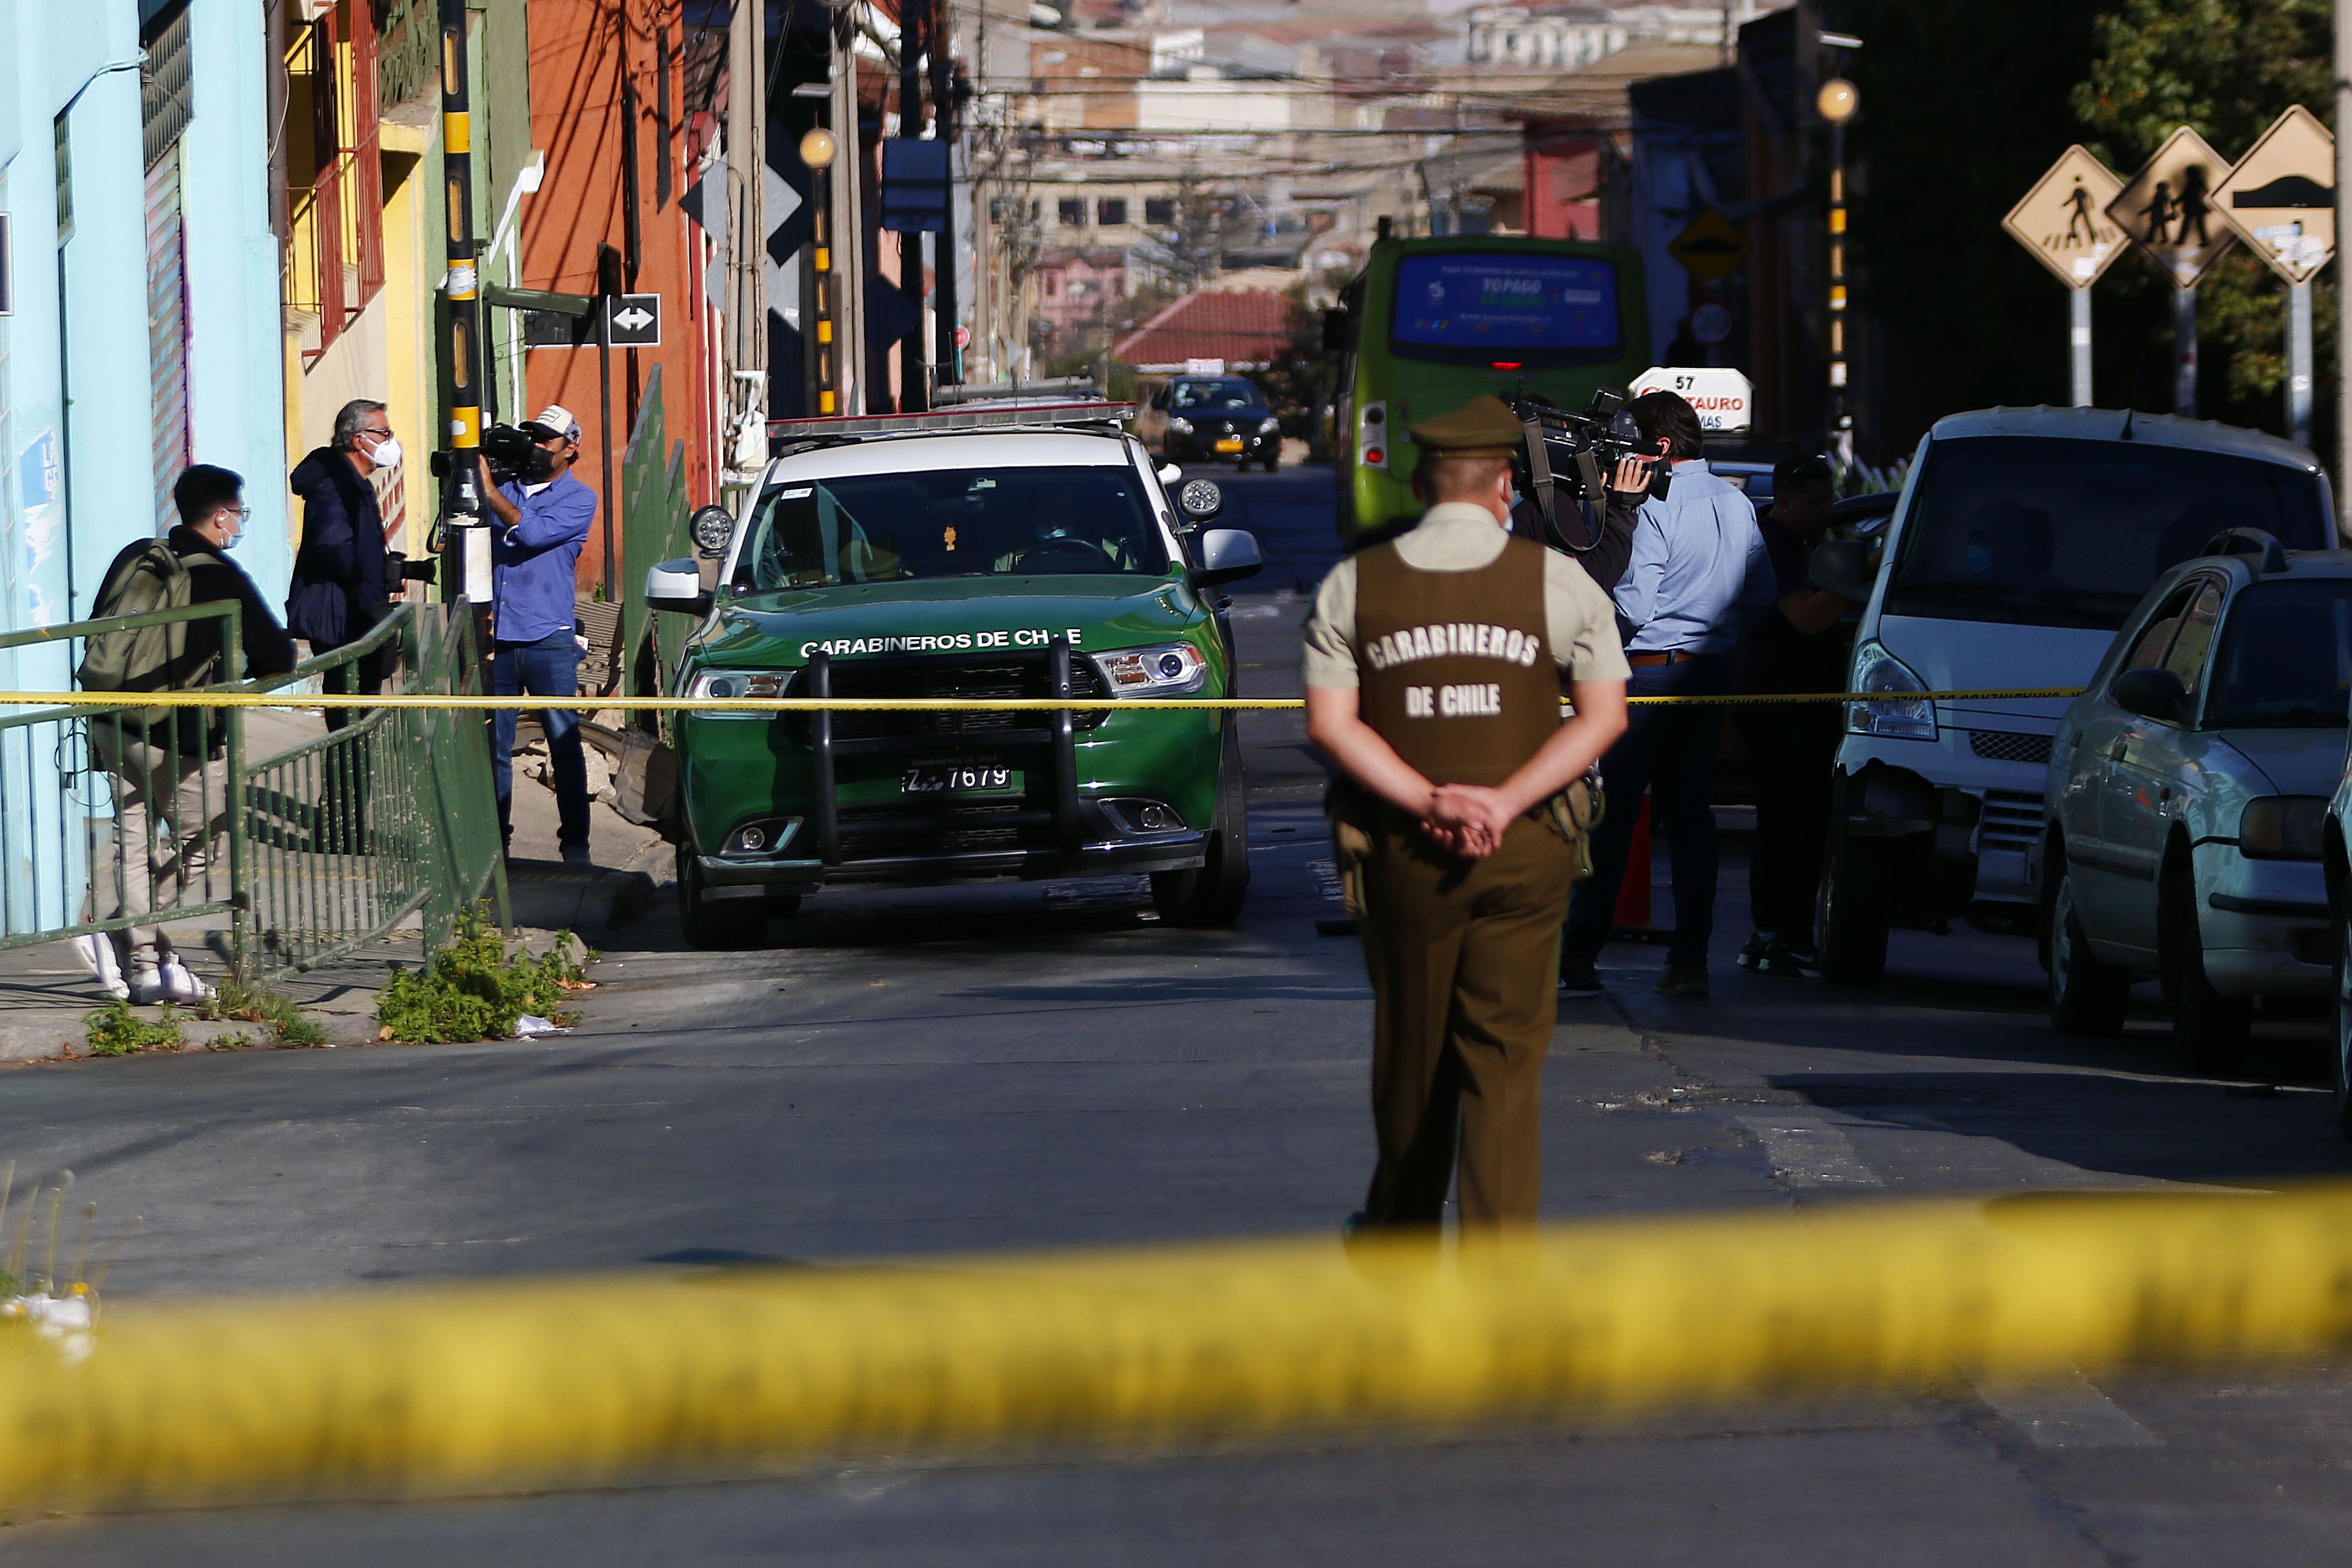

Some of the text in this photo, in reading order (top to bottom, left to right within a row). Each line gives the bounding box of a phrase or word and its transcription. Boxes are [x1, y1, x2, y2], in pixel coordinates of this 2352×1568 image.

[1483, 277, 1542, 292] YO PAGO
[1676, 376, 1694, 390] 57
[801, 628, 1082, 658] CARABINEROS DE CHE
[1367, 623, 1540, 670] CARABINEROS
[1405, 683, 1501, 718] DE CHILE
[947, 765, 1007, 788] 7679
